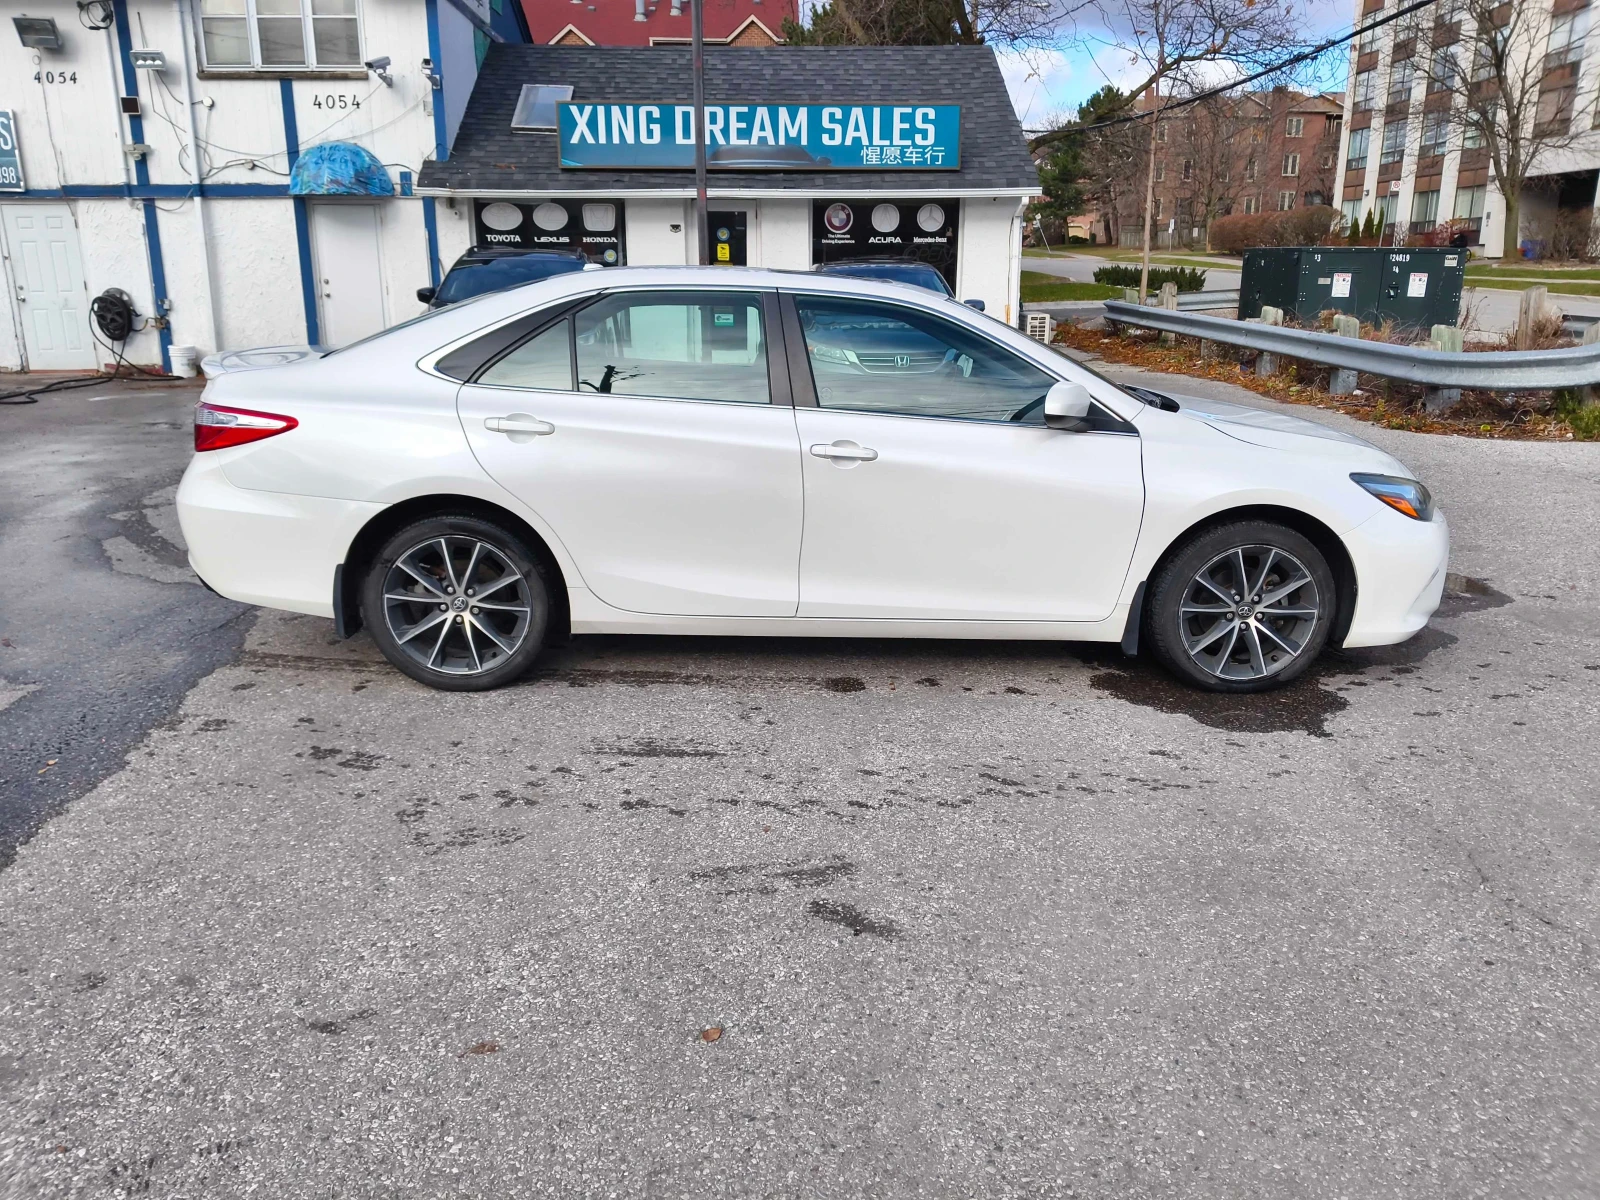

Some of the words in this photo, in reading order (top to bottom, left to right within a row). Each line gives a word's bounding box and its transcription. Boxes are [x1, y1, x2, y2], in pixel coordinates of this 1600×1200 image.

[33, 70, 78, 85] 4054
[312, 94, 361, 110] 4054
[568, 104, 661, 145] XING
[674, 105, 808, 146] DREAM
[821, 107, 936, 146] SALES
[860, 145, 946, 165] 惺愿车行
